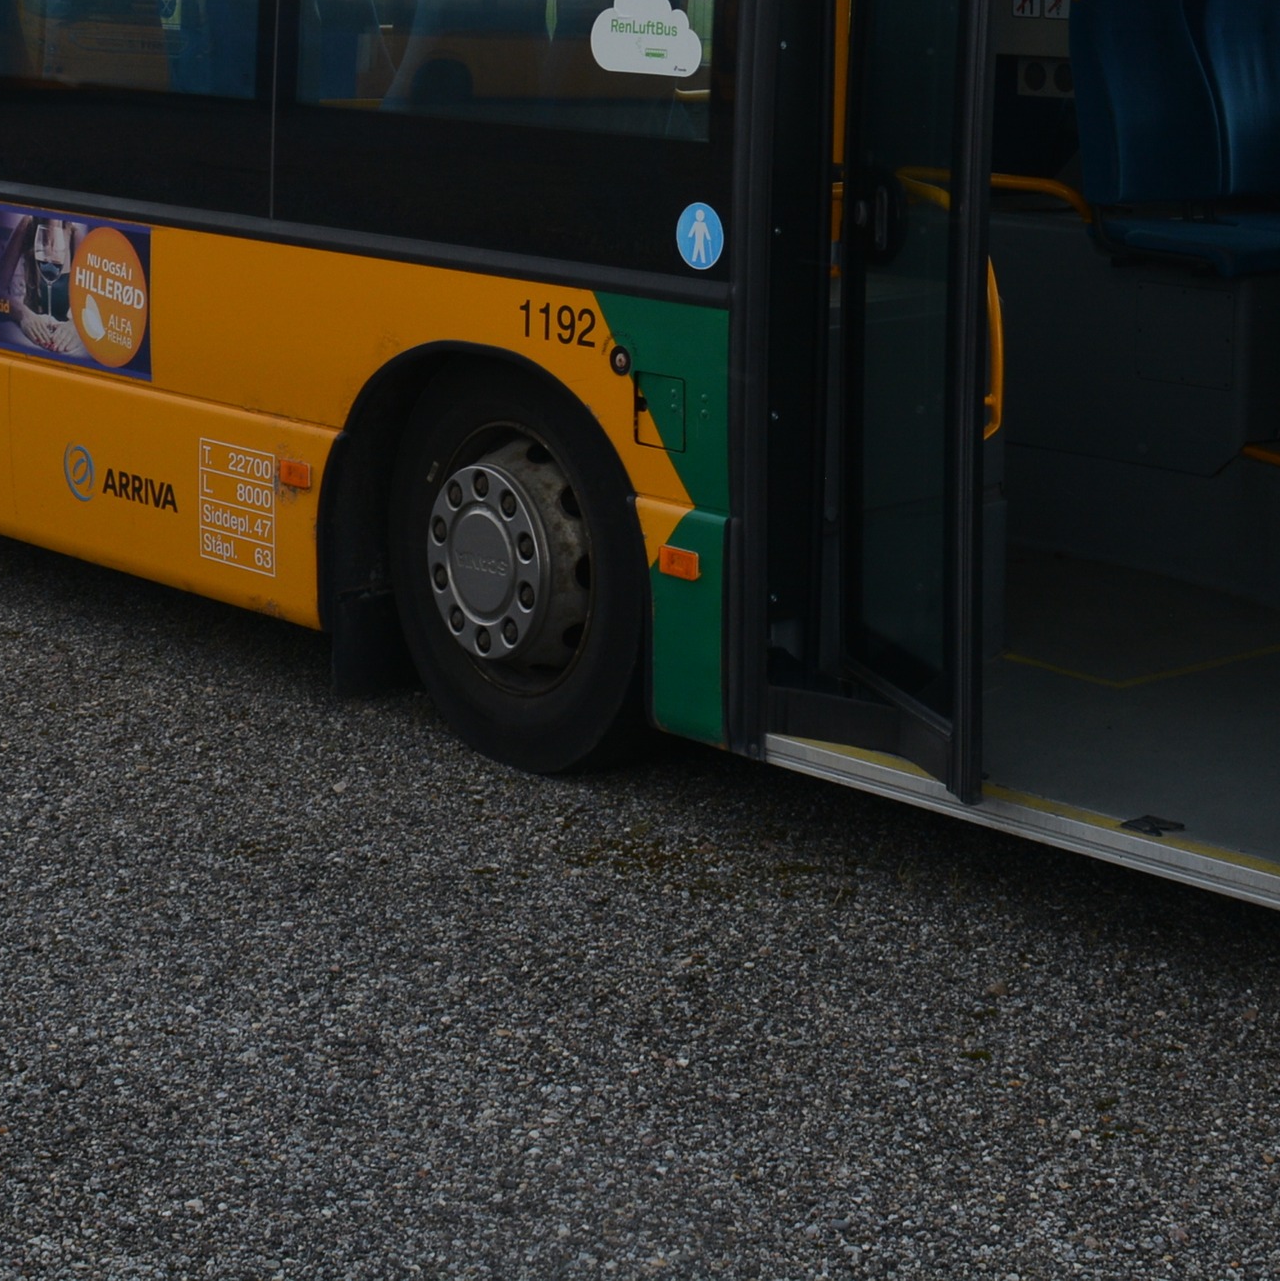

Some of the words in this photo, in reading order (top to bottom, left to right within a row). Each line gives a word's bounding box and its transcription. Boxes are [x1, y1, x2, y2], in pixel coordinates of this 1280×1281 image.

[610, 18, 678, 37] RenLuftBus
[87, 253, 101, 269] NU
[102, 258, 127, 279] OGSÅ
[128, 268, 132, 281] I
[75, 266, 145, 310] HILLERØD
[108, 314, 133, 336] ALFA
[520, 299, 596, 348] 1192
[107, 330, 133, 349] REHAB
[228, 452, 272, 479] 22700
[102, 468, 178, 514] ARRIVA
[236, 484, 272, 508] 8000
[203, 504, 253, 536] Siddepl.
[254, 519, 272, 538] 47
[203, 533, 238, 560] Ståpl.
[254, 547, 272, 568] 63
